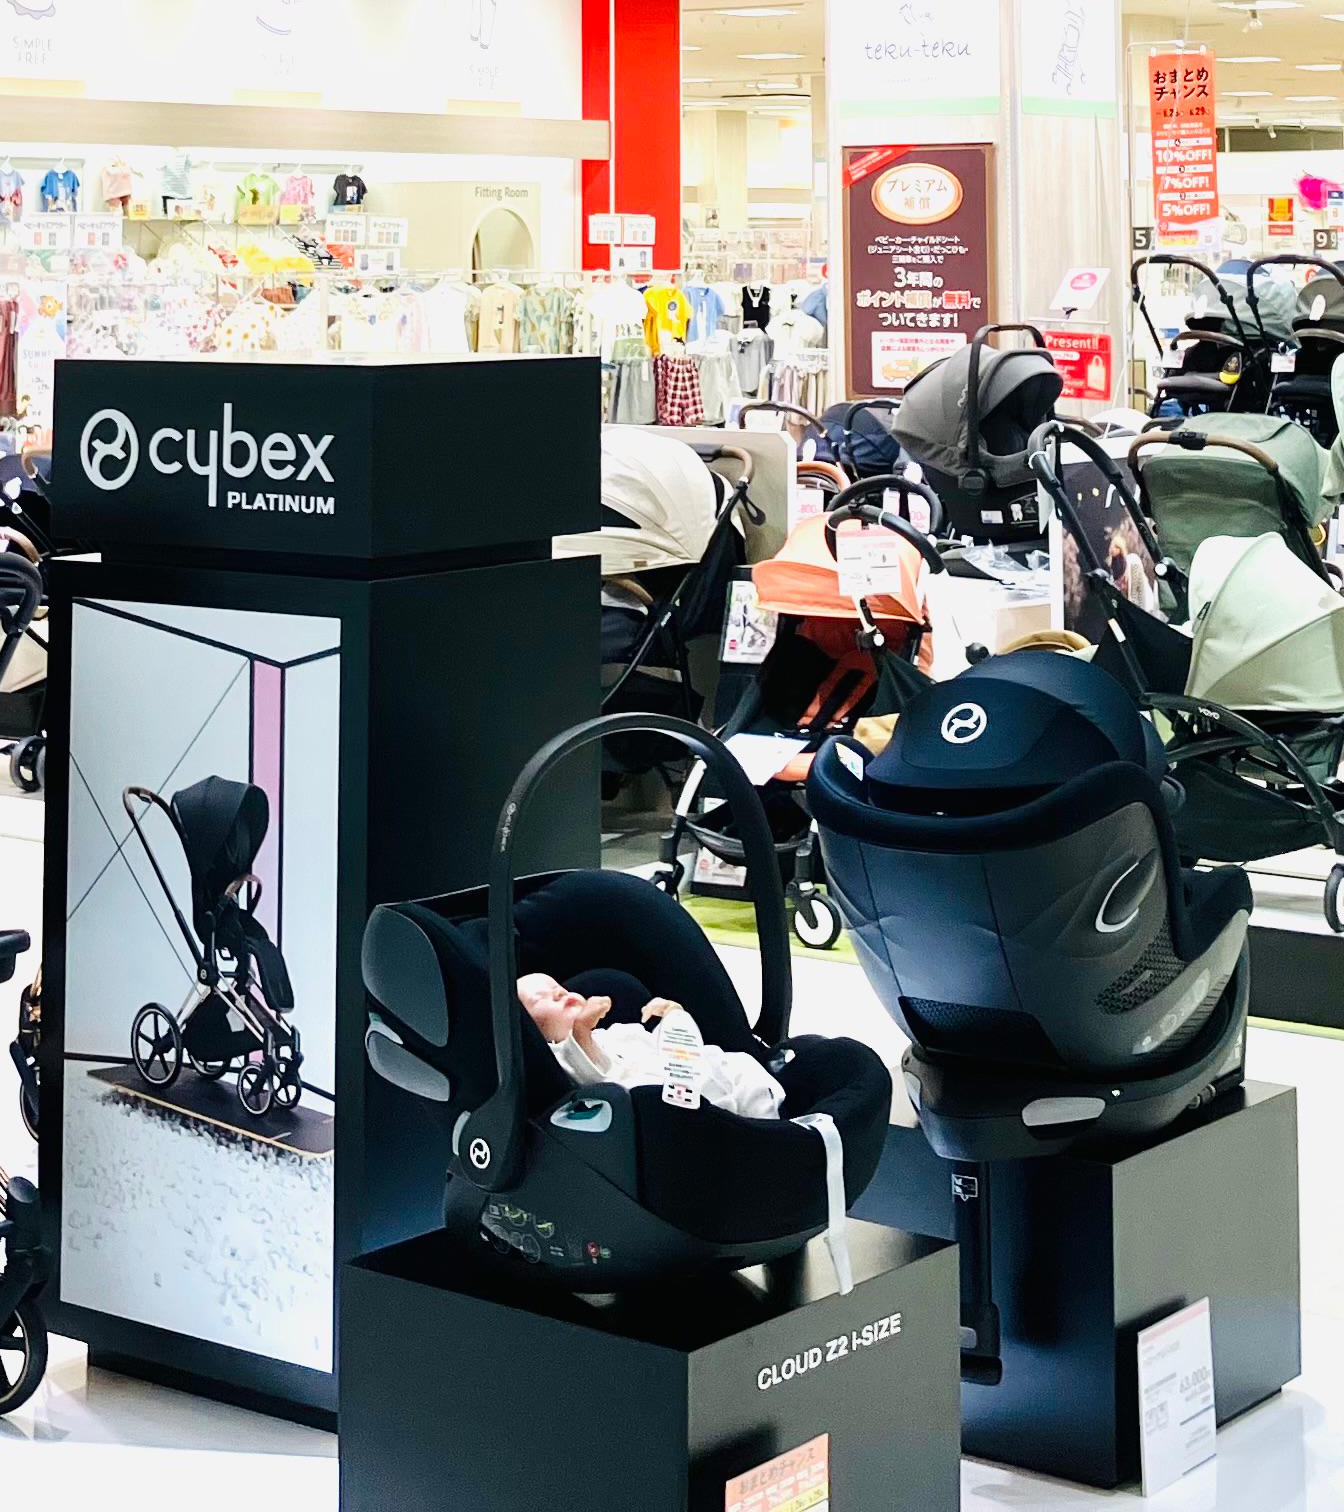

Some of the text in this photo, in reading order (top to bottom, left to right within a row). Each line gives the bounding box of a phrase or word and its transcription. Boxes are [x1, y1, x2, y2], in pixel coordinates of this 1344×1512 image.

[12, 35, 56, 51] SMPLE
[864, 39, 971, 61] teku-teku
[1156, 149, 1212, 162] 10%OFF!
[474, 186, 529, 202] Fitting Room
[886, 178, 948, 193] プレミアム
[1162, 203, 1211, 217] 5%OFF!
[1135, 229, 1147, 248] 5
[1316, 231, 1328, 248] 9
[894, 266, 944, 288] 3年間の
[149, 402, 335, 507] cybex
[227, 491, 335, 515] PLATINUM
[757, 1313, 902, 1391] CLOUD Z2 I-SIZE
